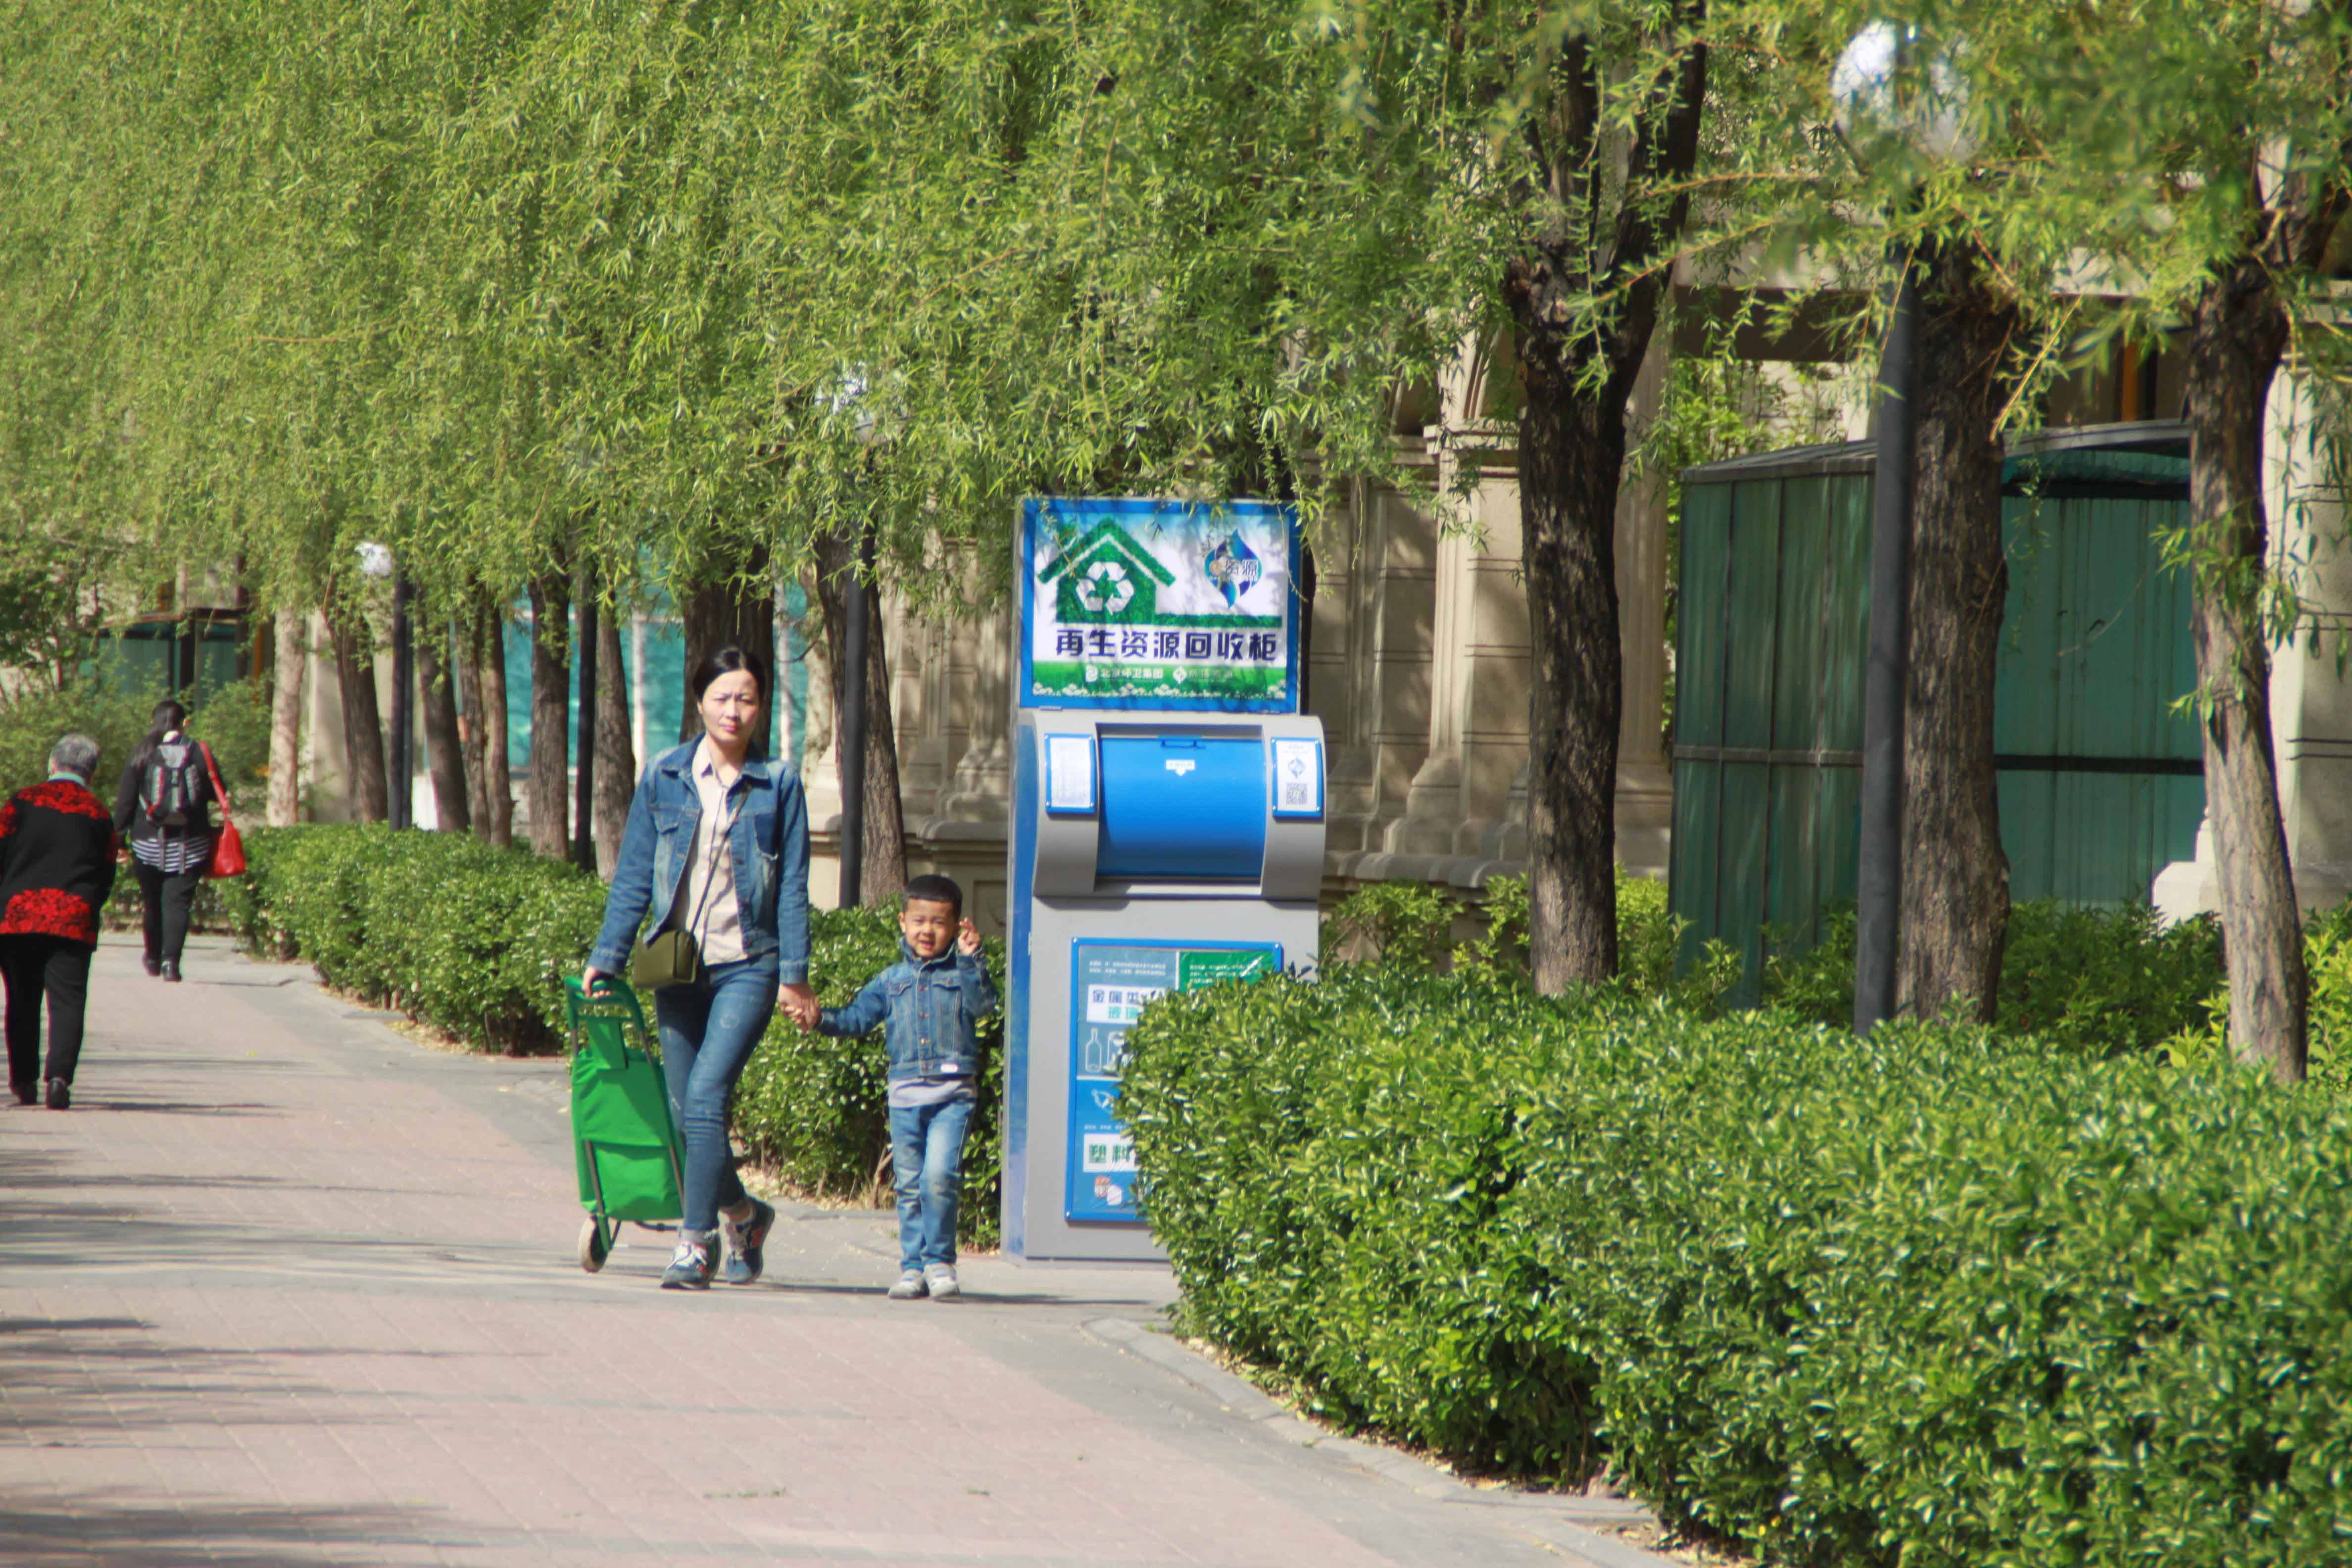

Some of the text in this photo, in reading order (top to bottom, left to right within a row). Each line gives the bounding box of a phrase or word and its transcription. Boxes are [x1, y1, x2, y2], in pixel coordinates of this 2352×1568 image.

[1056, 629, 1276, 661] 再生资源回收柜
